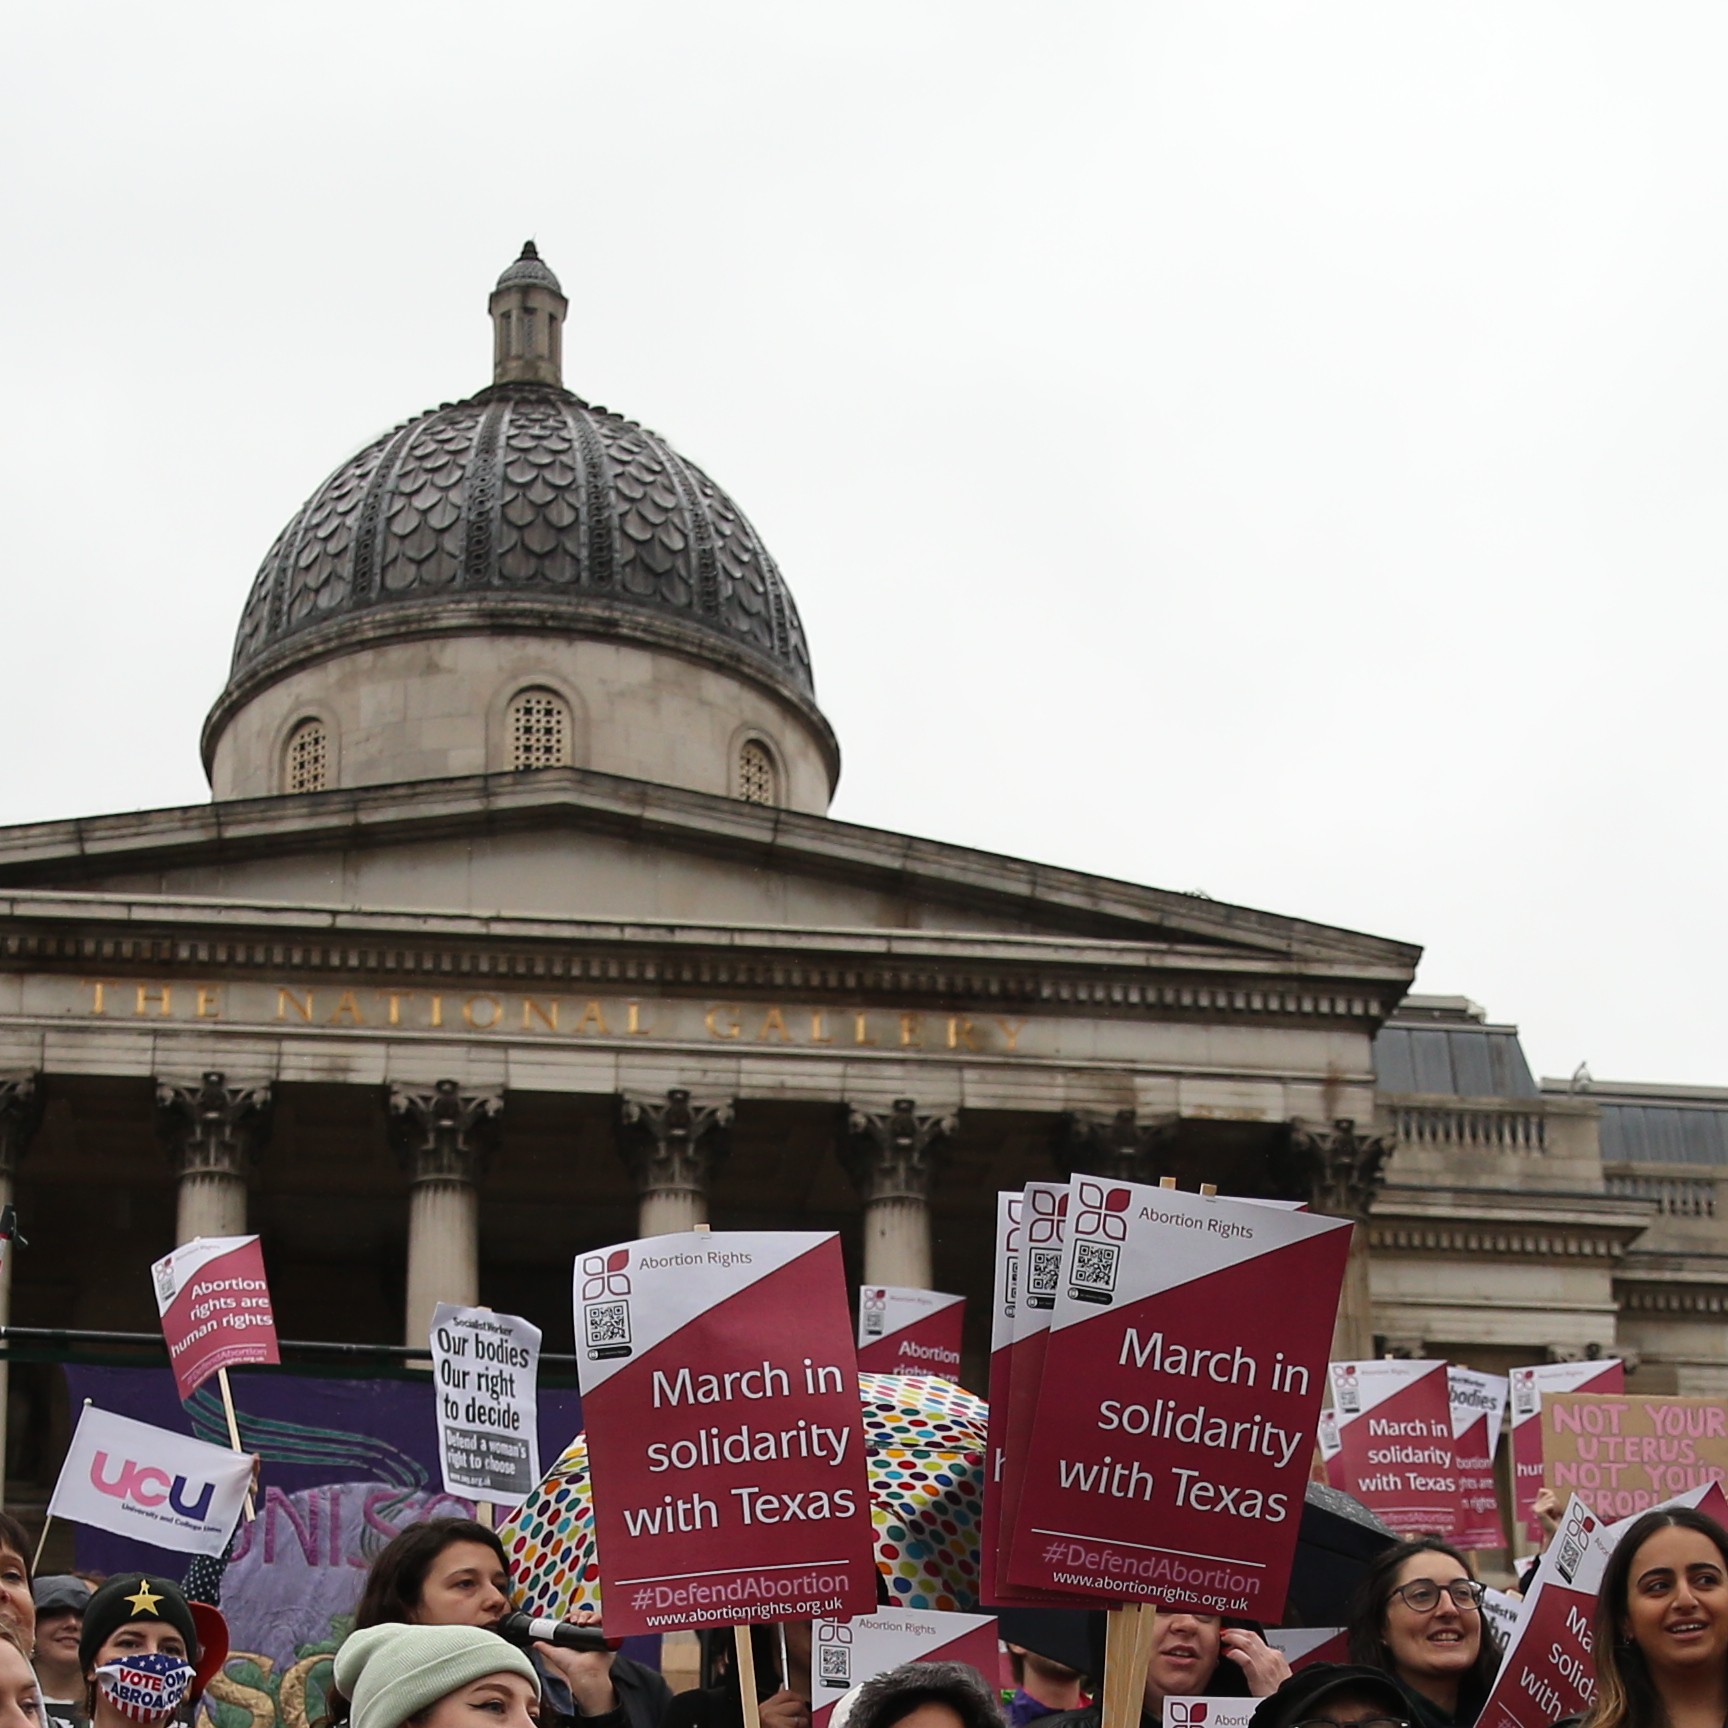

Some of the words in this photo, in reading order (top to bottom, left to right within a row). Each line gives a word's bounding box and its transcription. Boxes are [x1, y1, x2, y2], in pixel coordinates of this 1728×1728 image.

[81, 979, 223, 1020] THE
[275, 985, 651, 1035] NATIONAL
[704, 1003, 1033, 1051] GALLERY
[1138, 1207, 1203, 1230] Abortion
[1207, 1218, 1254, 1239] Rights
[639, 1252, 703, 1270] Abortion
[708, 1251, 752, 1266] Rights
[191, 1276, 266, 1300] Abortion
[189, 1294, 236, 1322] rights
[241, 1294, 270, 1308] are
[171, 1322, 218, 1359] human
[222, 1312, 272, 1330] rights
[437, 1329, 469, 1358] Our
[475, 1333, 530, 1369] bodies
[1118, 1328, 1257, 1386] March
[1272, 1352, 1309, 1395] in
[441, 1361, 472, 1390] Our
[477, 1366, 516, 1401] right
[652, 1361, 792, 1407] March
[803, 1359, 843, 1394] in
[444, 1397, 460, 1421] to
[465, 1399, 520, 1431] decide
[1369, 1418, 1428, 1438] March
[1431, 1422, 1448, 1438] in
[1552, 1402, 1630, 1437] NOT
[1645, 1406, 1727, 1439] YOUR
[446, 1429, 476, 1450] Defend
[479, 1438, 488, 1452] a
[490, 1439, 527, 1460] woman's
[647, 1420, 849, 1472] solidarity
[1098, 1400, 1302, 1468] solidarity
[447, 1448, 467, 1471] right
[469, 1452, 482, 1469] to
[484, 1456, 516, 1475] choose
[1368, 1445, 1451, 1468] solidarity
[1576, 1437, 1704, 1467] UTERUS,
[1059, 1457, 1154, 1500] with
[1172, 1467, 1288, 1522] Texas
[1358, 1474, 1405, 1492] with
[1409, 1473, 1455, 1492] Texas
[1553, 1461, 1624, 1488] NOT
[1643, 1463, 1728, 1492] YOUR
[121, 1503, 159, 1522] University
[159, 1512, 175, 1525] and
[175, 1518, 202, 1533] College
[624, 1494, 718, 1536] with
[730, 1487, 856, 1525] Texas
[1043, 1542, 1261, 1593] #DefendAbortion
[631, 1572, 849, 1612] #DefendAbortion
[1053, 1570, 1249, 1611] www.abortionrights.org.uk
[646, 1597, 842, 1627] www.abortionrights.org.uk
[119, 1668, 162, 1692] VOTE
